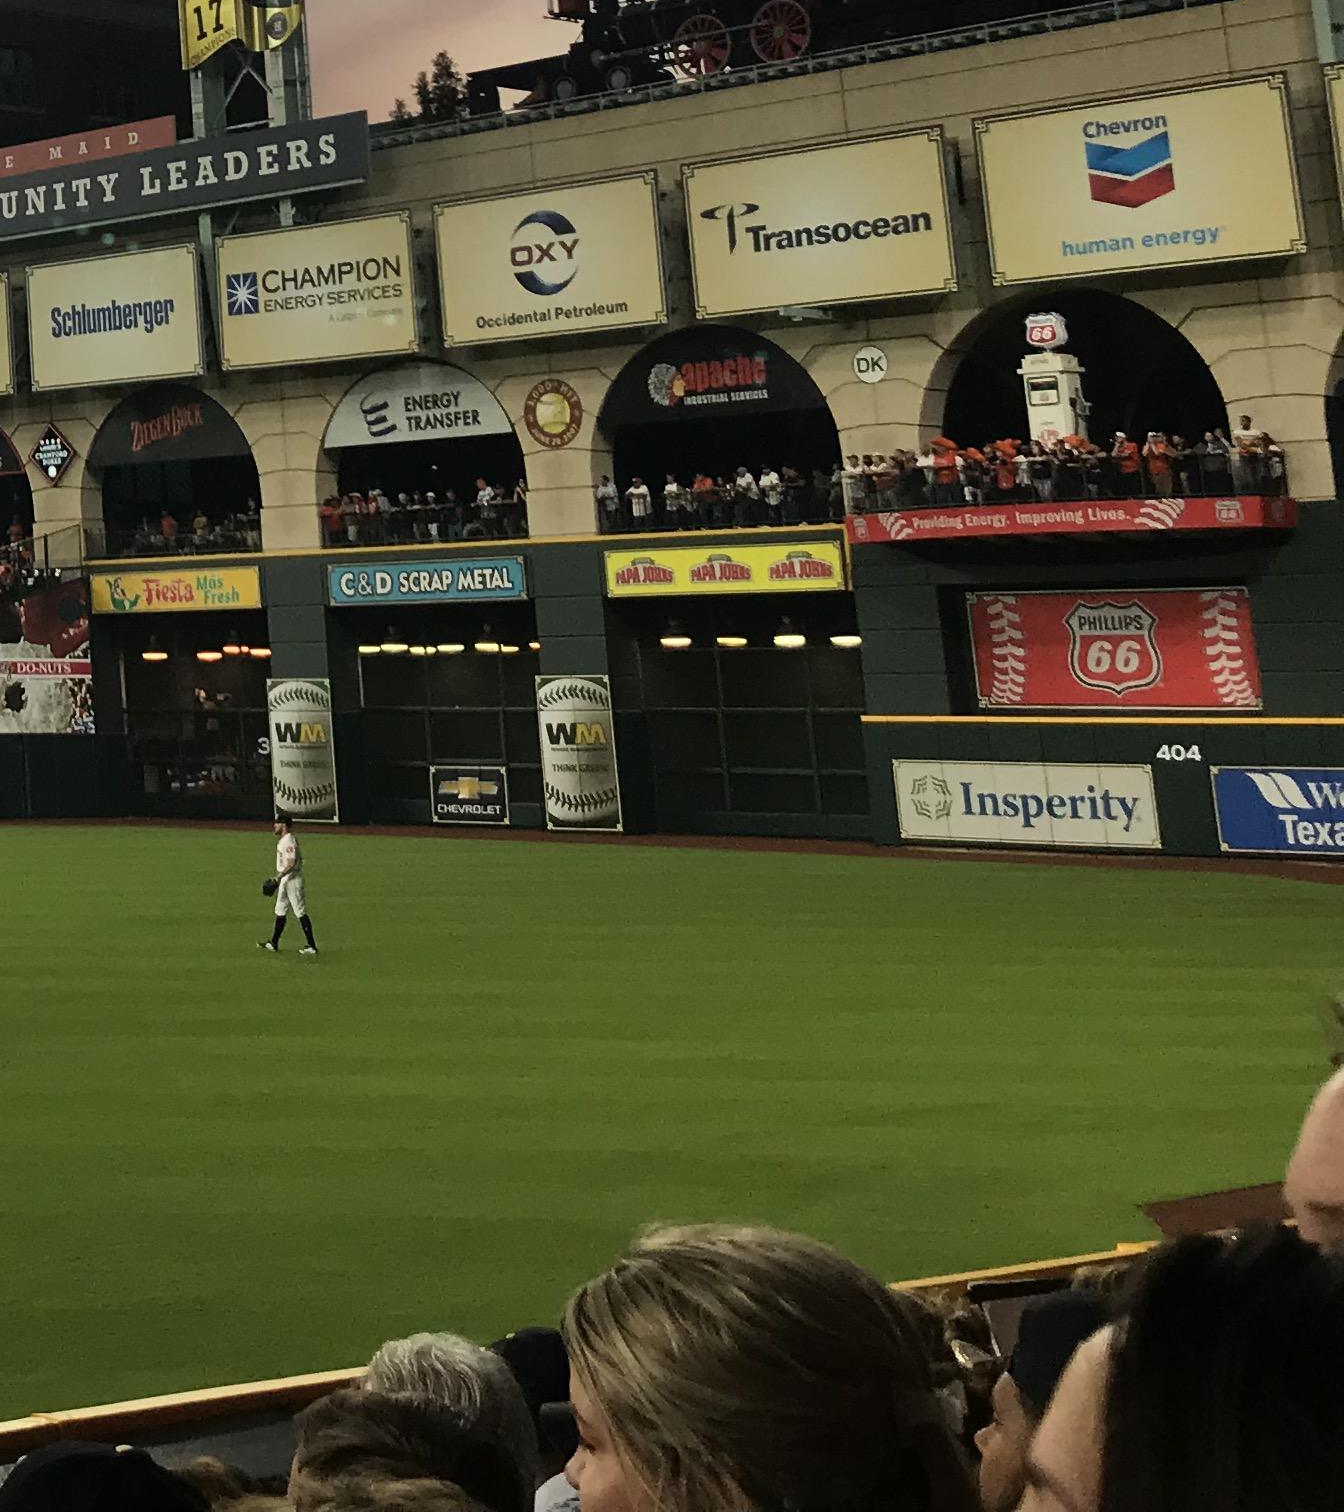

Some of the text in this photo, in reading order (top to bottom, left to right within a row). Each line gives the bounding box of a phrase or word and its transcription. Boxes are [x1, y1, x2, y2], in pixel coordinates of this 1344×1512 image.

[1082, 115, 1168, 139] Chevron
[140, 133, 338, 197] LEADERS
[746, 209, 932, 253] Transocean
[1061, 225, 1220, 257] human energy
[511, 238, 580, 267] OXY
[262, 255, 401, 293] CHAMPION
[264, 283, 403, 312] ENERGY SERVICES
[51, 298, 176, 339] Schlumberger
[476, 299, 629, 329] Occidental Petroleum
[1032, 326, 1052, 340] 66
[856, 355, 884, 374] DK
[404, 391, 461, 413] ENERGY
[683, 389, 769, 405] INDUSTRIAL SERVICES
[405, 408, 480, 432] TRANSFER
[912, 505, 1131, 530] Providing Energy. Improving Lives.
[399, 568, 453, 593] SCRAP
[458, 564, 513, 591] METAL
[616, 569, 640, 584] PAPA
[691, 564, 716, 580] PAPA
[769, 561, 795, 578] PAPA
[142, 577, 194, 606] Fiesta
[204, 586, 239, 604] Fresh
[1078, 613, 1144, 632] PHILLIPS
[16, 661, 71, 674] DO-NUTS
[1086, 639, 1141, 674] 66
[275, 722, 328, 743] WM
[545, 722, 606, 745] WM
[257, 737, 270, 755] 3
[1156, 744, 1201, 761] 404
[438, 803, 502, 815] CHEVROLET
[960, 781, 1140, 832] Insperity
